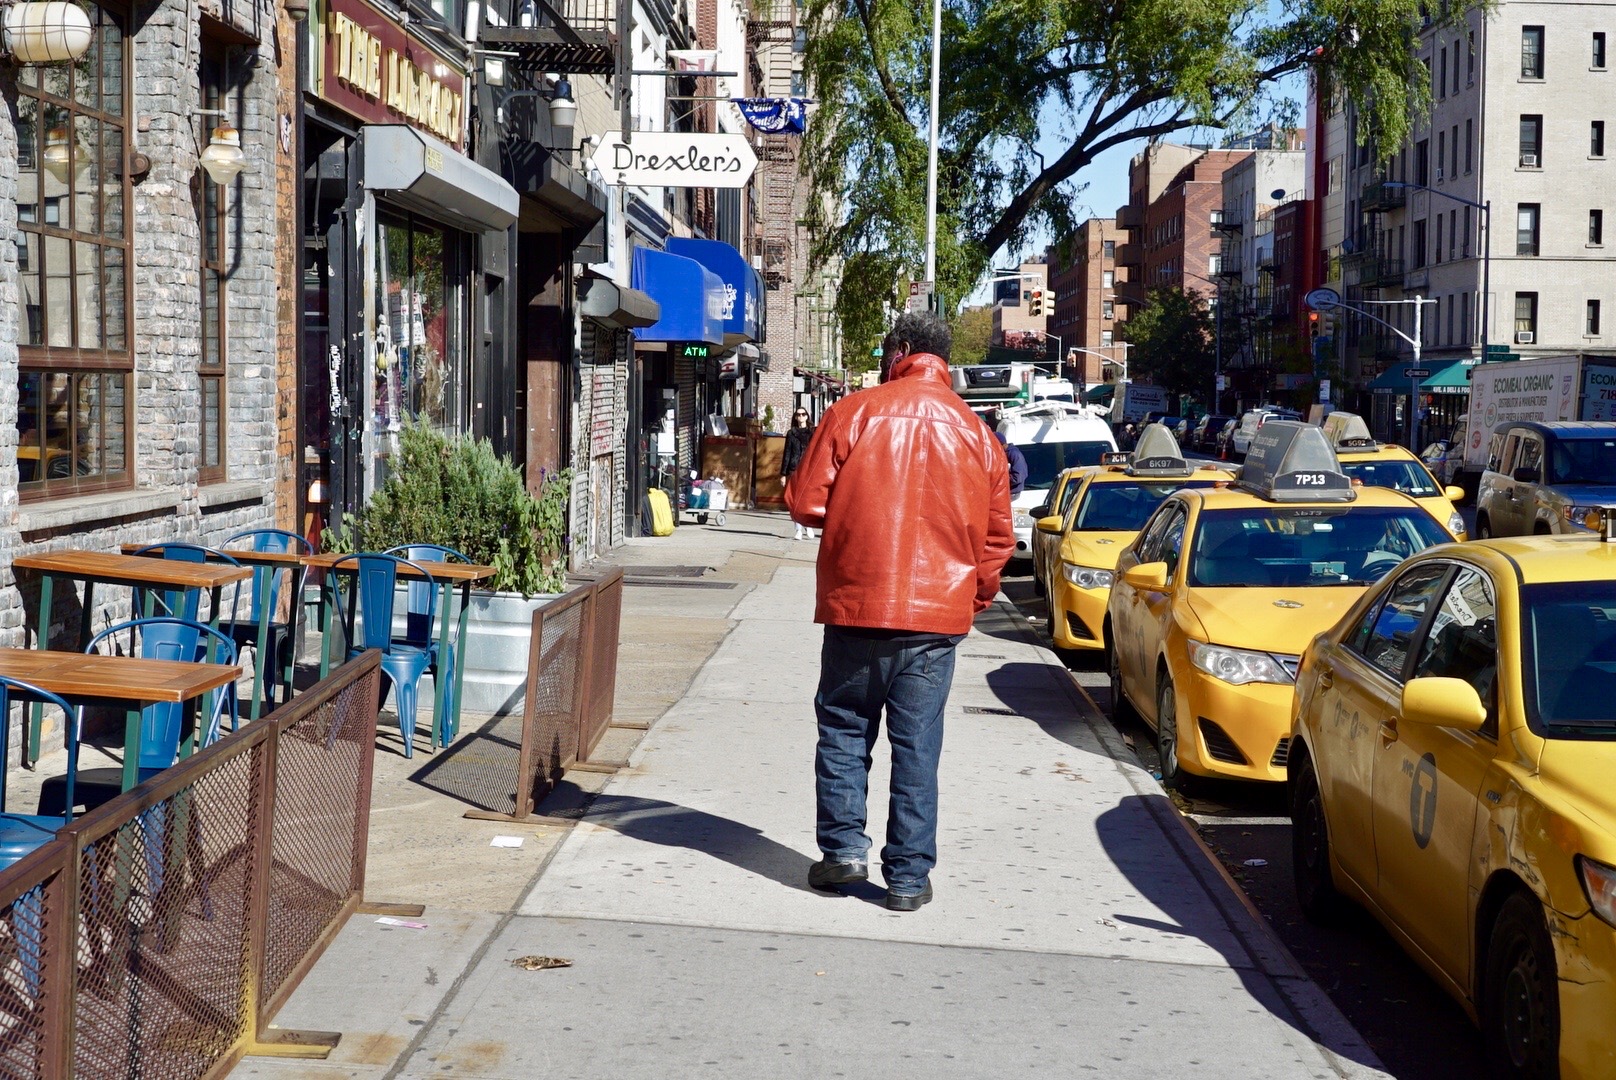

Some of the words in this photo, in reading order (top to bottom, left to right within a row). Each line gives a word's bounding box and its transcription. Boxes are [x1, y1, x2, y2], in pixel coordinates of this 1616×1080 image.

[332, 12, 382, 99] THE
[386, 48, 462, 143] LIBRARY
[612, 143, 742, 173] Drexler's
[684, 346, 707, 357] ATM
[1493, 377, 1522, 394] ECOMEAL
[1523, 374, 1554, 393] ORGANIC
[1149, 459, 1172, 468] 6K97
[1295, 474, 1326, 485] 7P13
[1418, 769, 1434, 836] T
